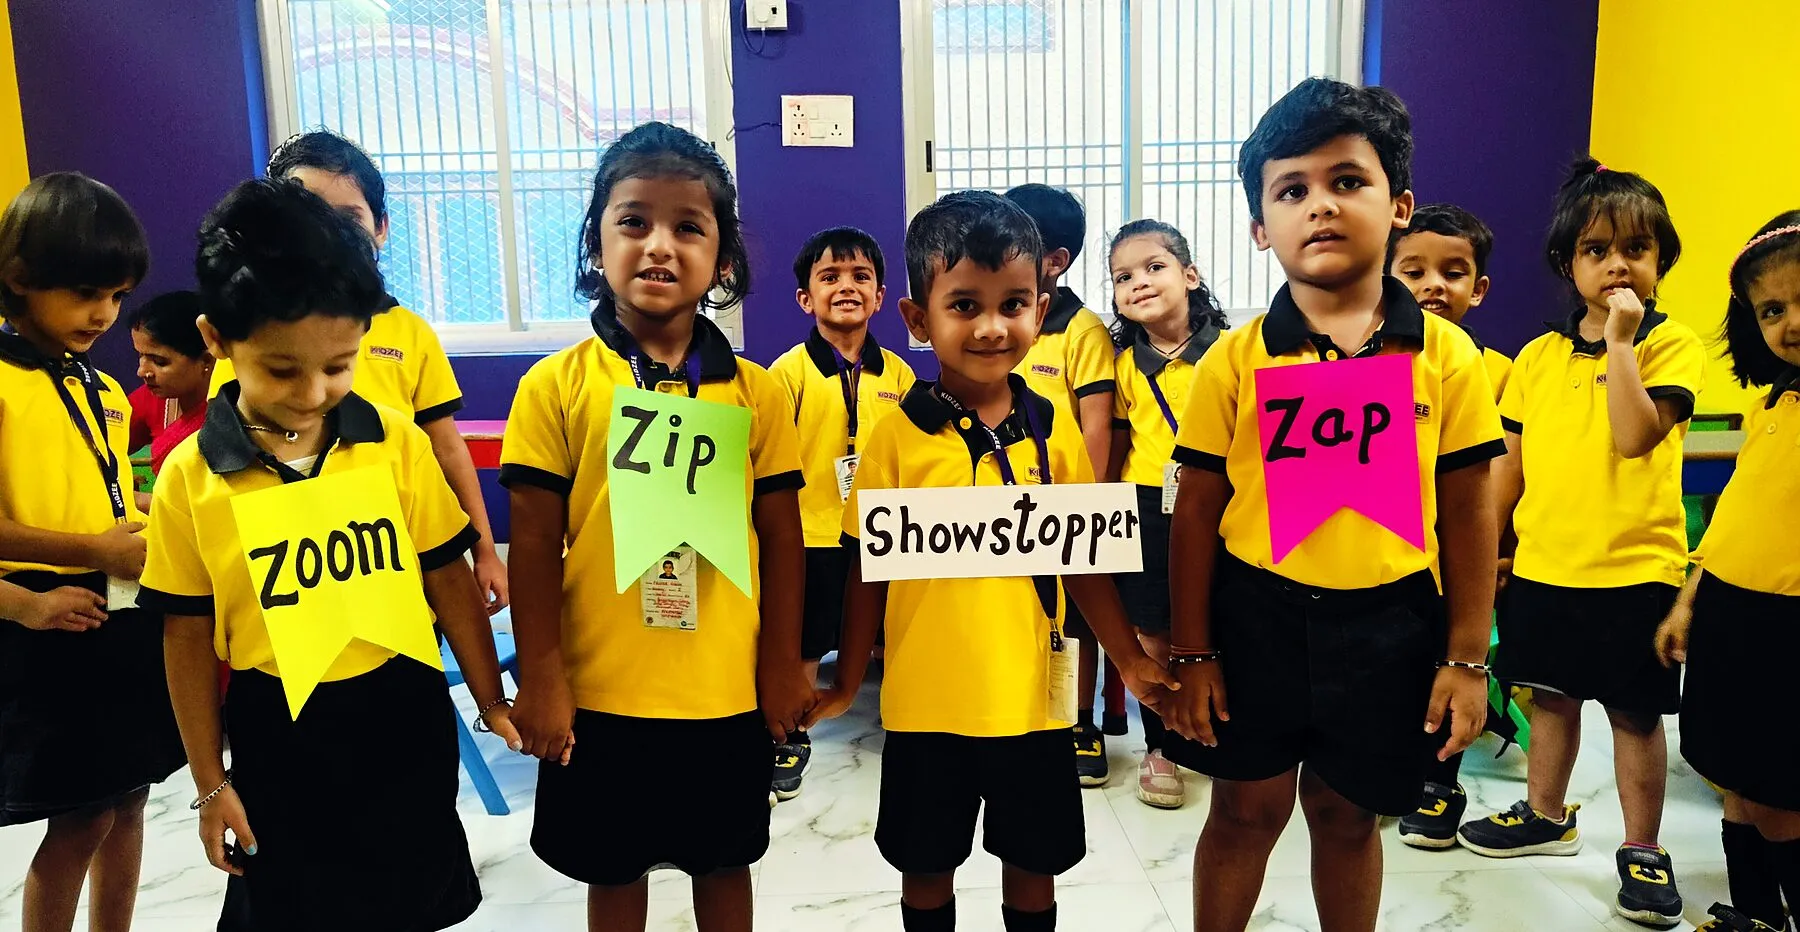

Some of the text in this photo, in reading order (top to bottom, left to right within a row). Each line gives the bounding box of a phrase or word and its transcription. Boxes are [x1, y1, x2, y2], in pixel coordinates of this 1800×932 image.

[630, 355, 641, 382] KIDZEE
[612, 405, 716, 495] Zip
[1263, 395, 1391, 465] Zap
[111, 482, 124, 509] KIDZEE
[865, 492, 1140, 567] Showstopper
